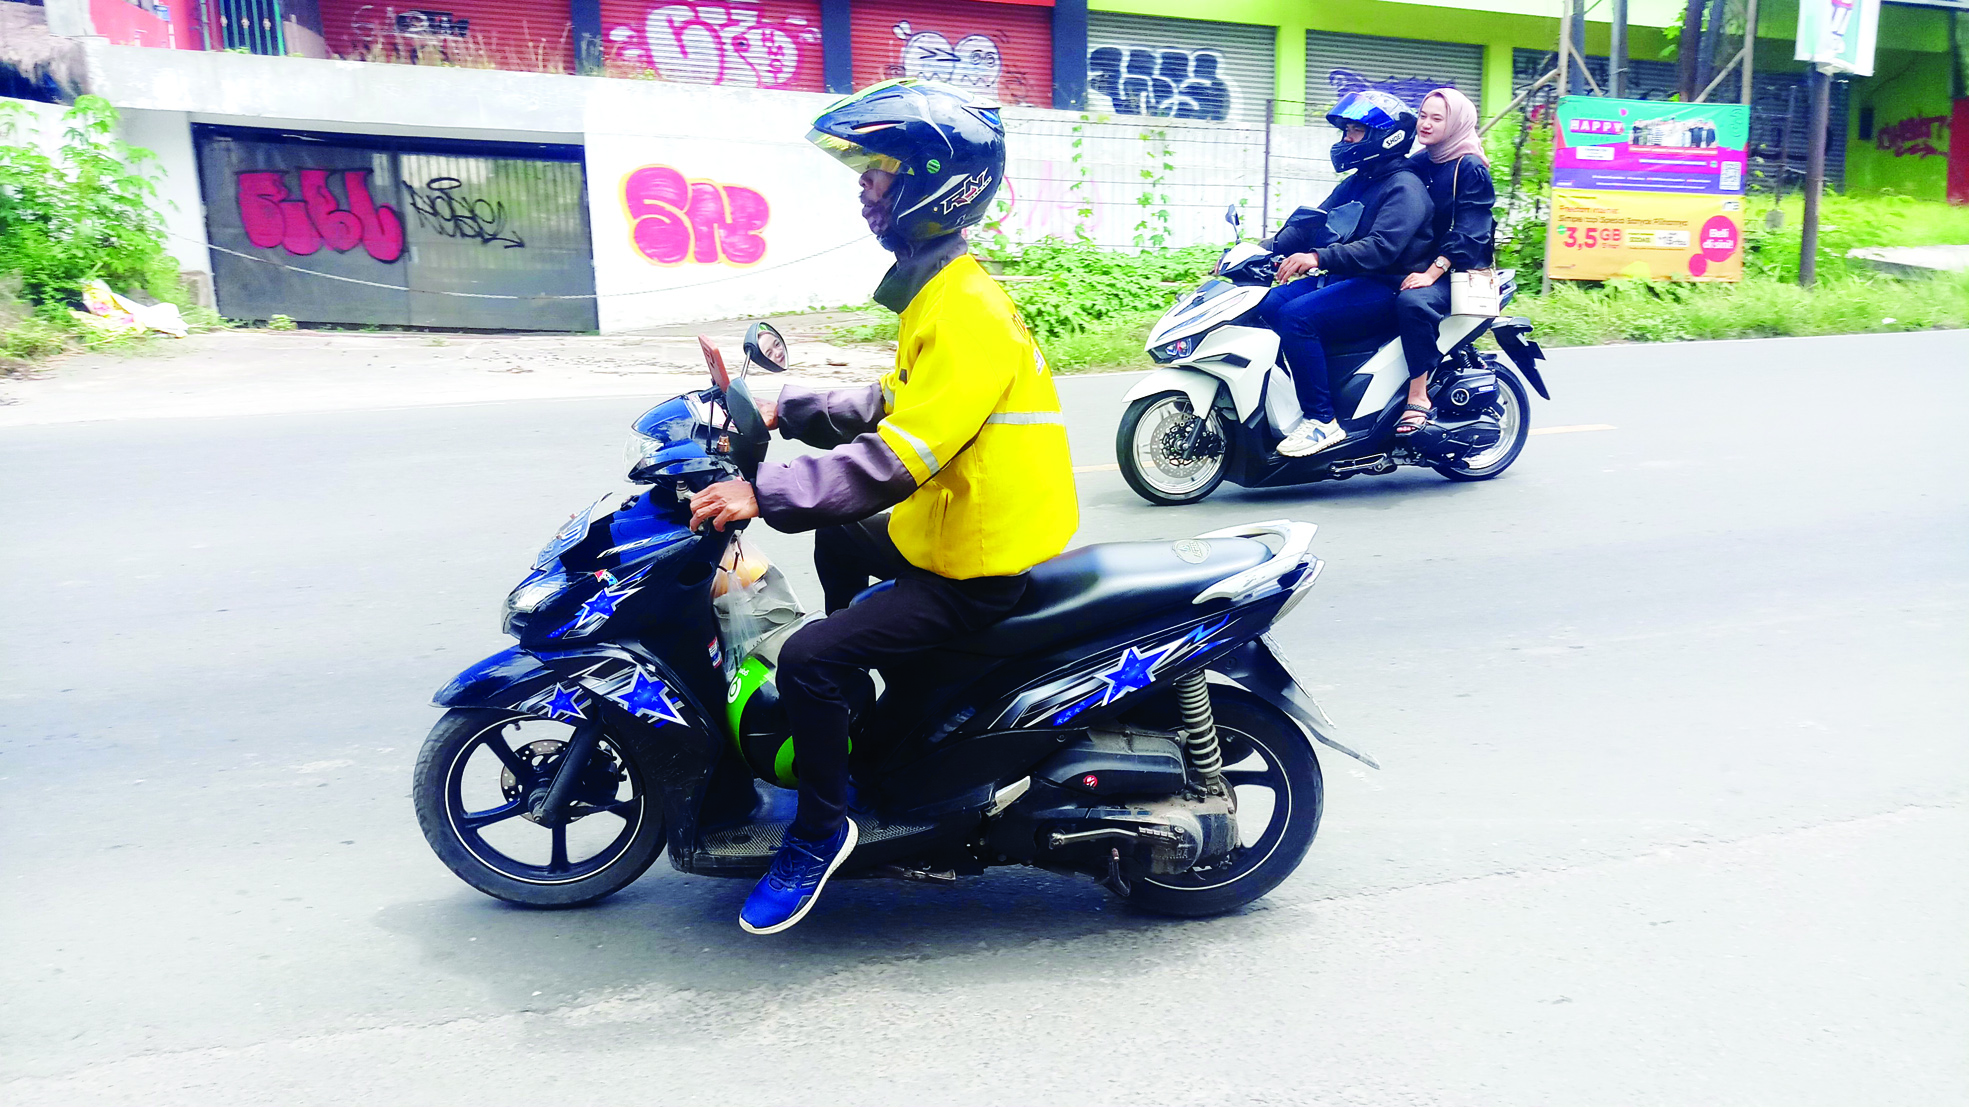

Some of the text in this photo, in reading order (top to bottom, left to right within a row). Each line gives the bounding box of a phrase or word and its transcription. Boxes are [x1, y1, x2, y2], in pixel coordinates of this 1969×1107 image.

[1570, 120, 1624, 133] HAPPY
[1564, 227, 1598, 250] 3,5
[1600, 228, 1621, 241] GB
